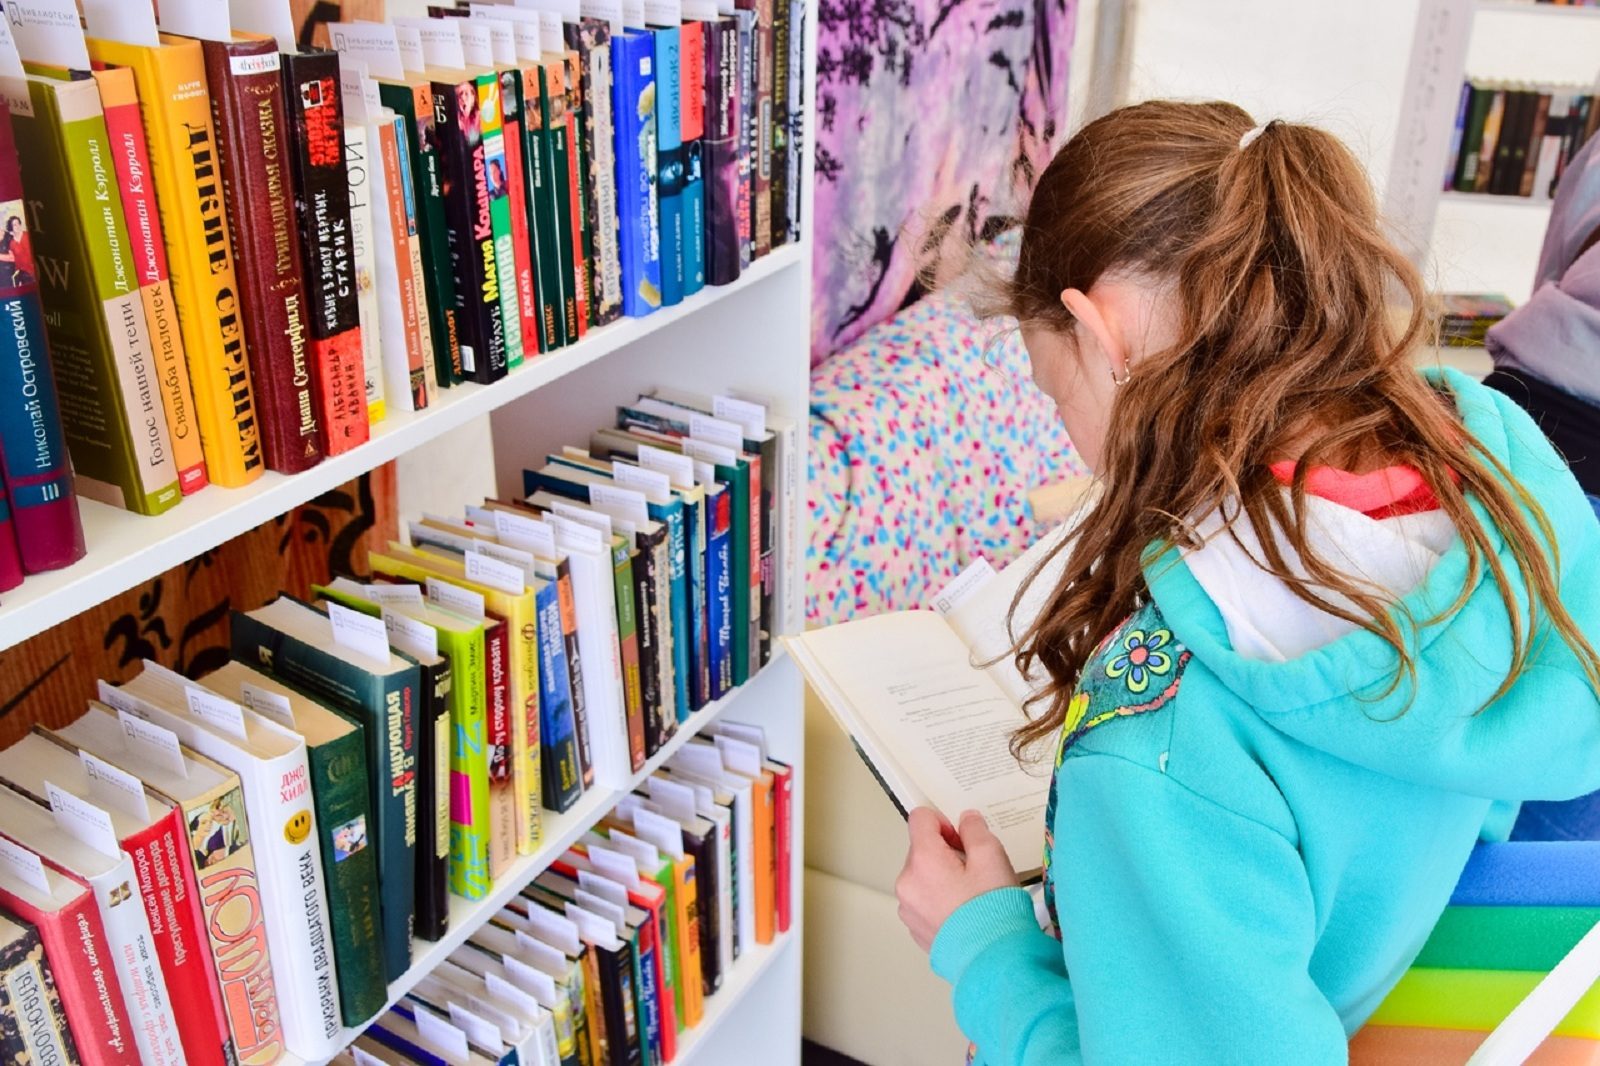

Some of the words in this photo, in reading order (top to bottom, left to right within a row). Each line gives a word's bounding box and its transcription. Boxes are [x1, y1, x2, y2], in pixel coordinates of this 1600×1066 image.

[258, 99, 278, 160] СКАЗКА
[87, 138, 110, 201] Кэрролл
[123, 132, 145, 195] Кэрролл
[103, 205, 129, 292] Джонатан
[136, 199, 161, 281] Джонатан
[265, 164, 291, 276] ТРИНАДЦАТАЯ
[320, 245, 334, 280] ЭПОХУ
[323, 281, 335, 291] В
[332, 218, 349, 298] СТАРИК
[119, 302, 142, 350] тени
[152, 286, 176, 362] палочек
[183, 122, 231, 276] ДИКИЕ
[214, 286, 262, 473] СЕРДЦЕМ
[324, 292, 339, 331] ЖИВЫЕ
[10, 298, 40, 398] Островский
[284, 294, 312, 386] Сеттерфилд
[129, 352, 154, 411] нашей
[164, 364, 190, 441] Свадьба
[299, 386, 319, 438] Диана
[27, 399, 53, 469] Николай
[141, 410, 165, 468] Голос
[282, 764, 305, 790] ДЖО
[135, 847, 154, 893] Моторов
[149, 839, 171, 888] доктора
[163, 830, 186, 903] Паровозова
[297, 849, 316, 889] ВЕКА
[143, 892, 164, 936] Алексей
[160, 887, 188, 967] Преступление
[304, 889, 329, 971] ДВАДЦАТОГО
[15, 970, 61, 1066] ВДОЛЮБЦЫ
[317, 970, 340, 1040] ПРИЗРАКИ
